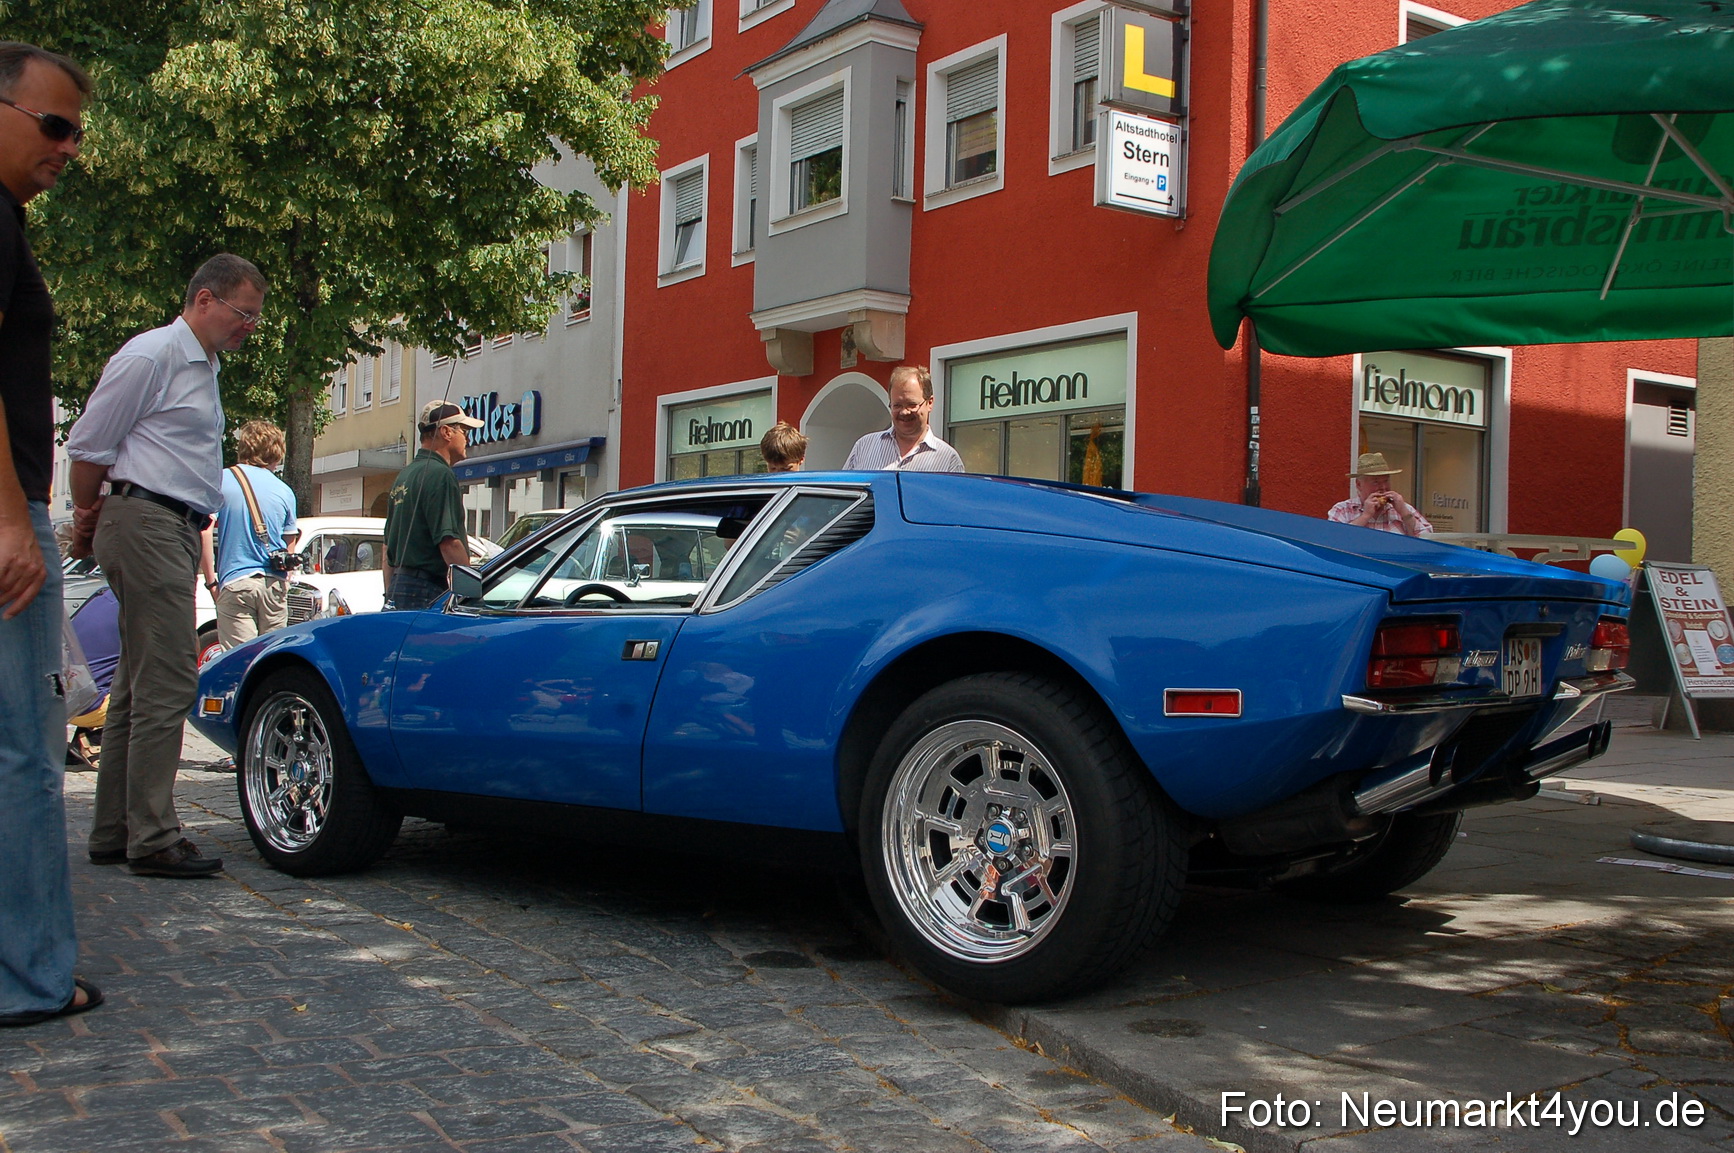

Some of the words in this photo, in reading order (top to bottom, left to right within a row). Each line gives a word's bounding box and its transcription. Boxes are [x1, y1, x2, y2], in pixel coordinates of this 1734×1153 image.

[1123, 24, 1176, 98] L
[1115, 120, 1178, 144] Altstadthotel
[1123, 140, 1170, 168] Stern
[1124, 172, 1150, 186] Eingang
[1659, 570, 1703, 585] EDEL
[1675, 586, 1689, 597] &
[1660, 597, 1719, 611] STEIN
[1510, 639, 1523, 666] AS
[1507, 670, 1521, 695] DP
